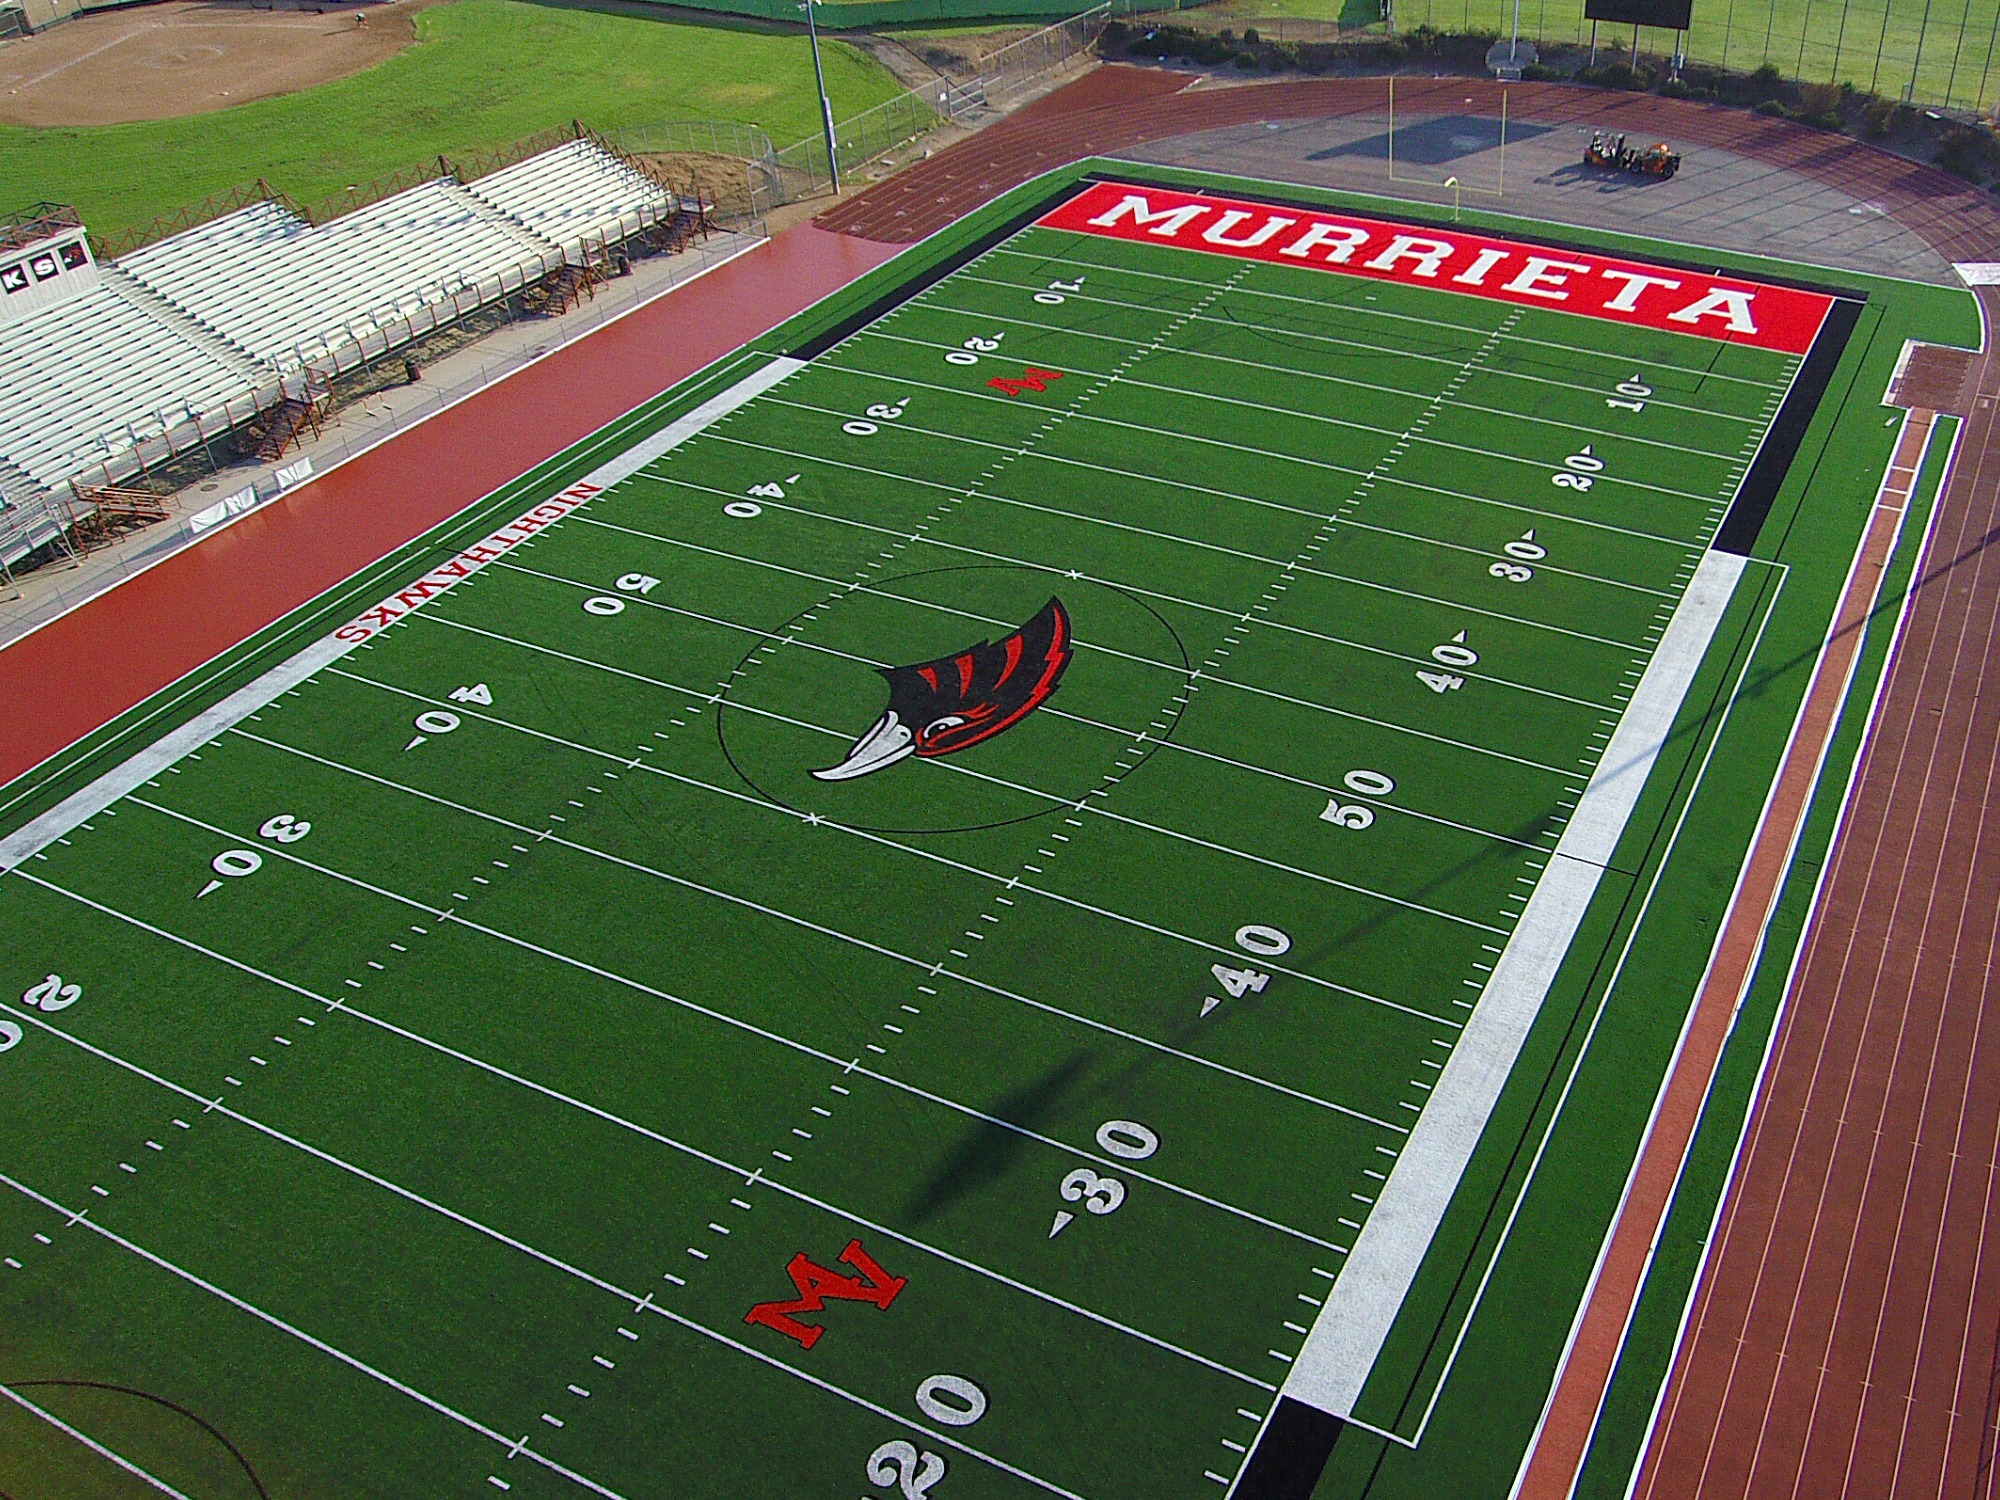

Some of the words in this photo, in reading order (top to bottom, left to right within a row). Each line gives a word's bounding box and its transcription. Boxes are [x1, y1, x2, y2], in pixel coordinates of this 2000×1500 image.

[1087, 195, 1758, 335] MURRIETA
[1034, 280, 1080, 304] 10
[945, 336, 999, 365] 20
[842, 404, 903, 436] 30
[1606, 383, 1652, 413] 10
[1551, 455, 1604, 492] 20
[723, 482, 785, 518] 40
[335, 482, 603, 643] NIGHTHAWKS
[1488, 541, 1546, 583] 30
[583, 573, 661, 615] 50
[1415, 645, 1478, 694] 40
[415, 683, 494, 733] 40
[1318, 770, 1394, 830] 50
[212, 814, 311, 877] 30
[1210, 925, 1290, 998] 40
[1060, 1120, 1158, 1214] 30
[866, 1374, 987, 1500] 20
